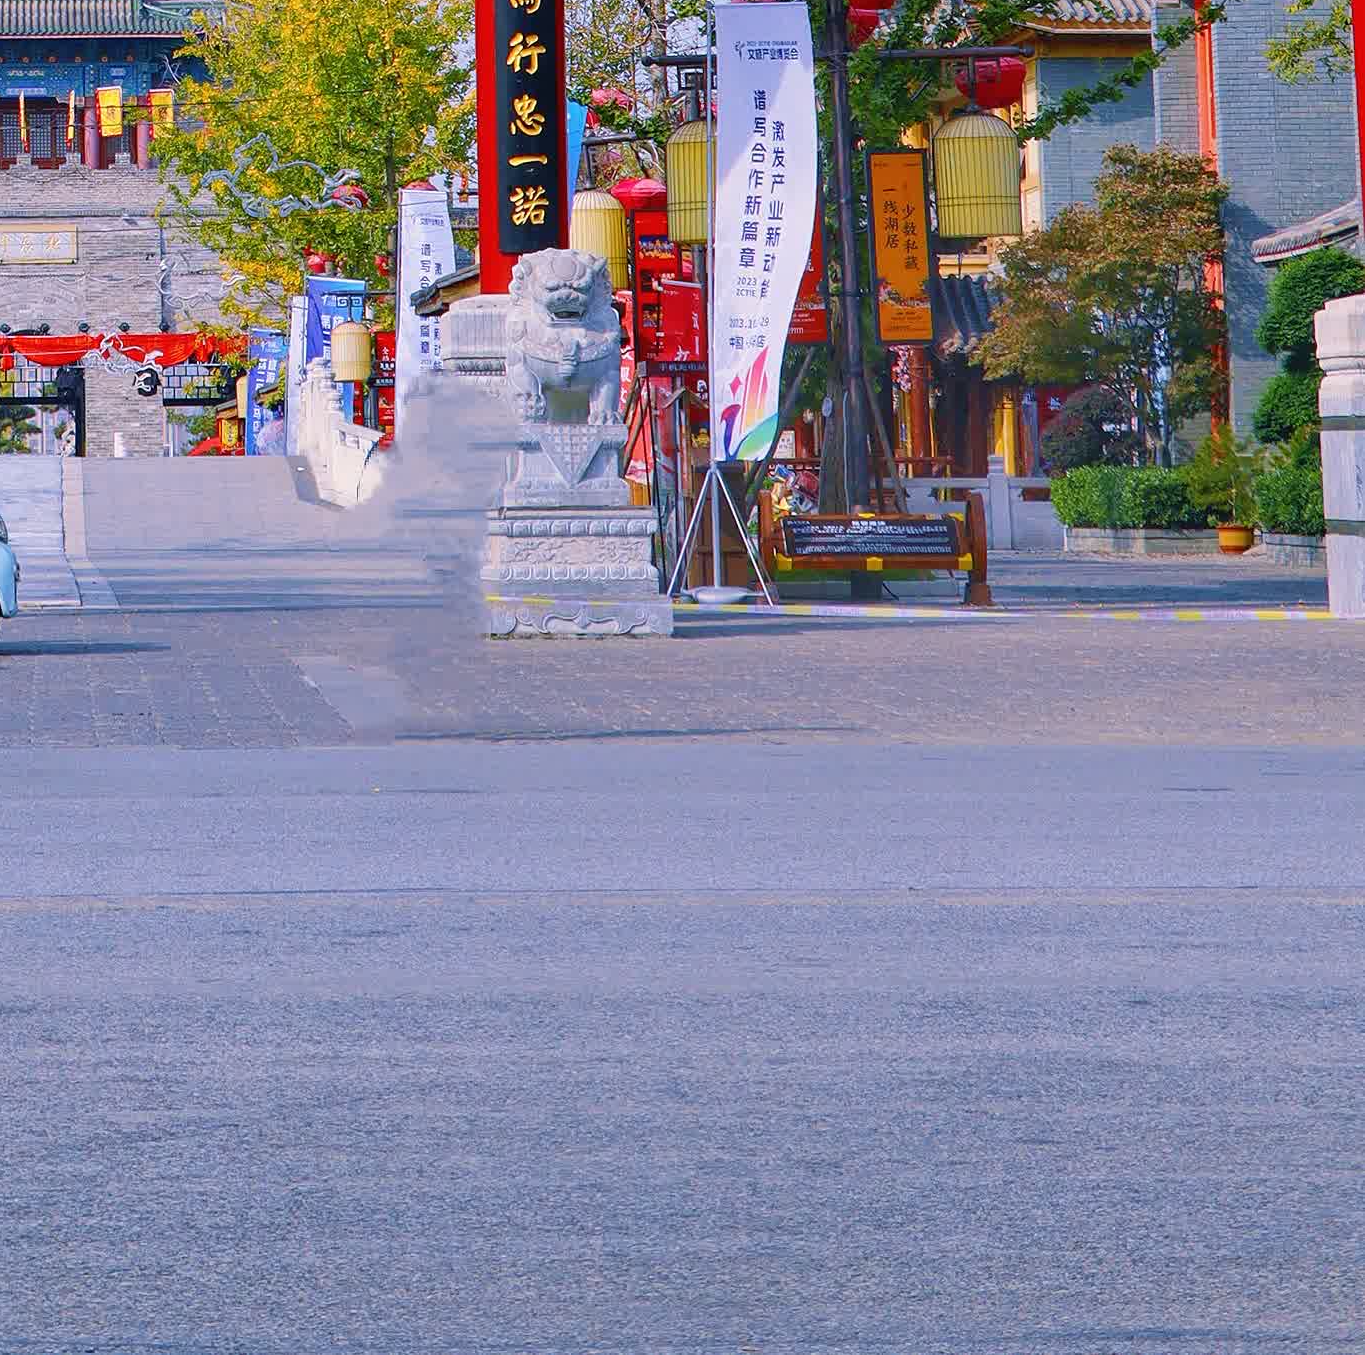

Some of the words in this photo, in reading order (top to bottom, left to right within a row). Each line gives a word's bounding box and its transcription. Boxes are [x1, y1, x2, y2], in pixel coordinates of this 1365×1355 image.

[739, 89, 767, 268] 谱写合作新篇章
